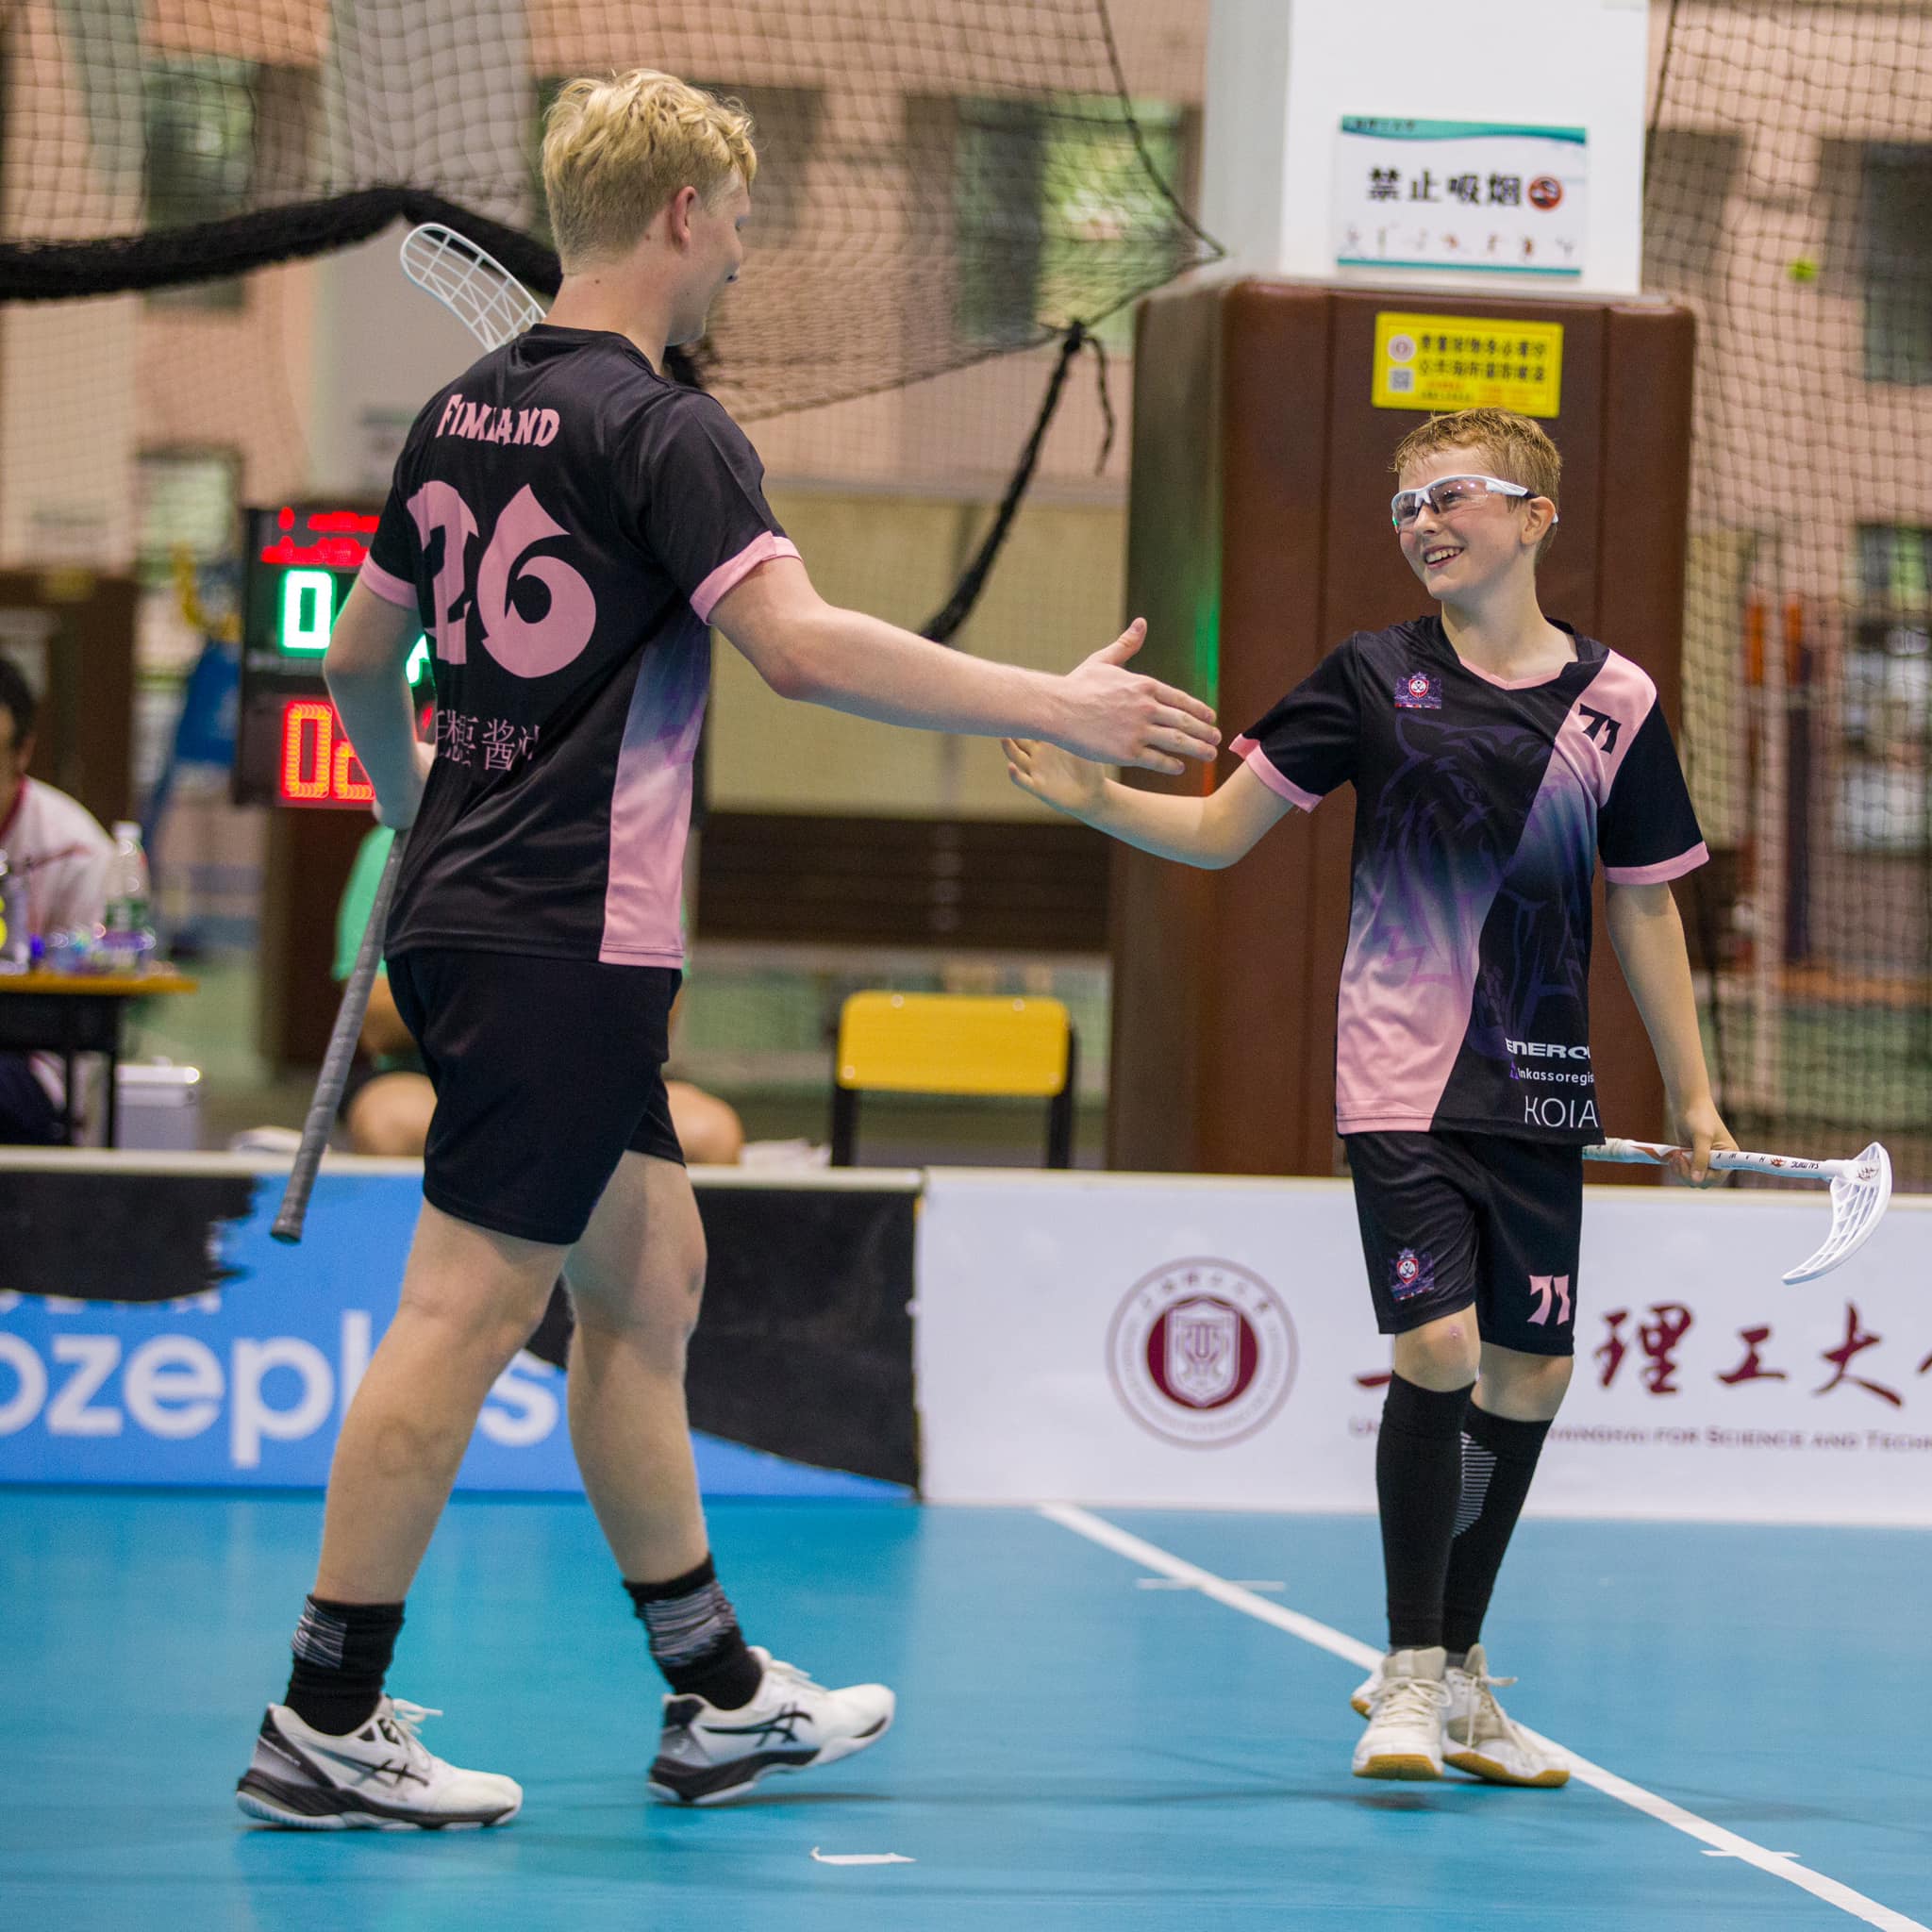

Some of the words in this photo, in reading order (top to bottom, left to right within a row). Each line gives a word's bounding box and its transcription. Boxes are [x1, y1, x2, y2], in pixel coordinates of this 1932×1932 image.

[1369, 167, 1522, 207] 禁止吸烟
[435, 393, 560, 447] FIMLAND
[1594, 1301, 1932, 1407] 理工大
